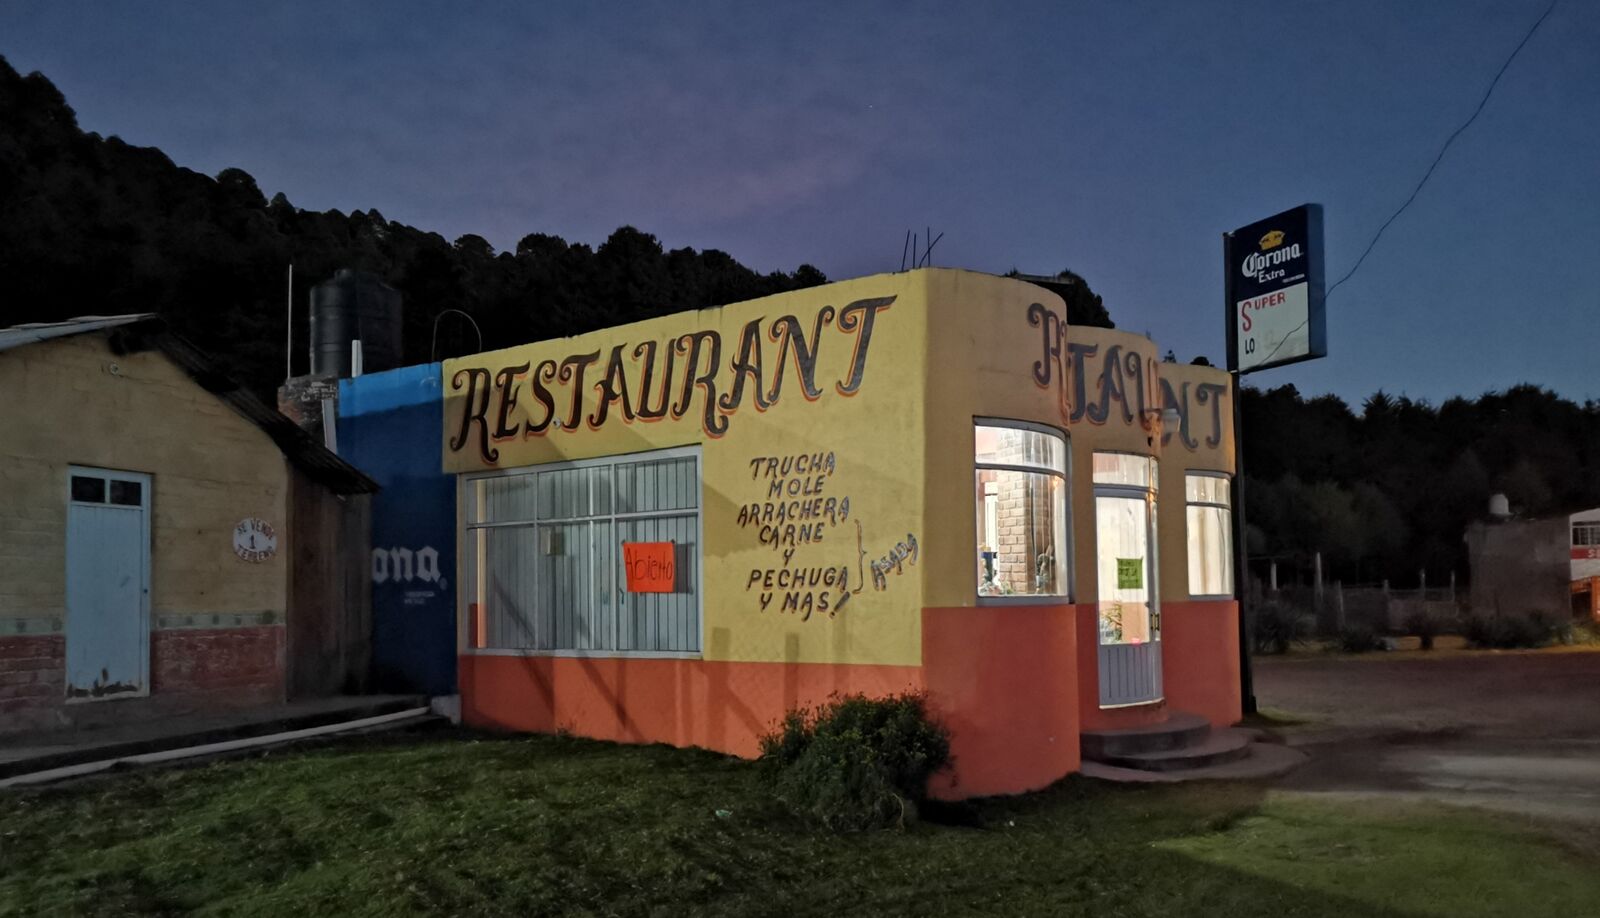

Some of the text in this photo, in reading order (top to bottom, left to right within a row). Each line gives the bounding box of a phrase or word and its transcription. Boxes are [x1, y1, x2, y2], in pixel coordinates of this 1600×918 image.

[1242, 243, 1301, 278] Corona
[1258, 268, 1286, 283] Extra
[450, 295, 898, 463] RESTAURANT
[750, 451, 836, 480] TRUCHA
[768, 475, 825, 499] MOLE
[737, 496, 850, 528] ARRACHERA
[759, 522, 825, 550] CARNE
[783, 549, 795, 567] Y
[746, 566, 849, 594] PECHUGA
[760, 592, 850, 622] Y MAS!
